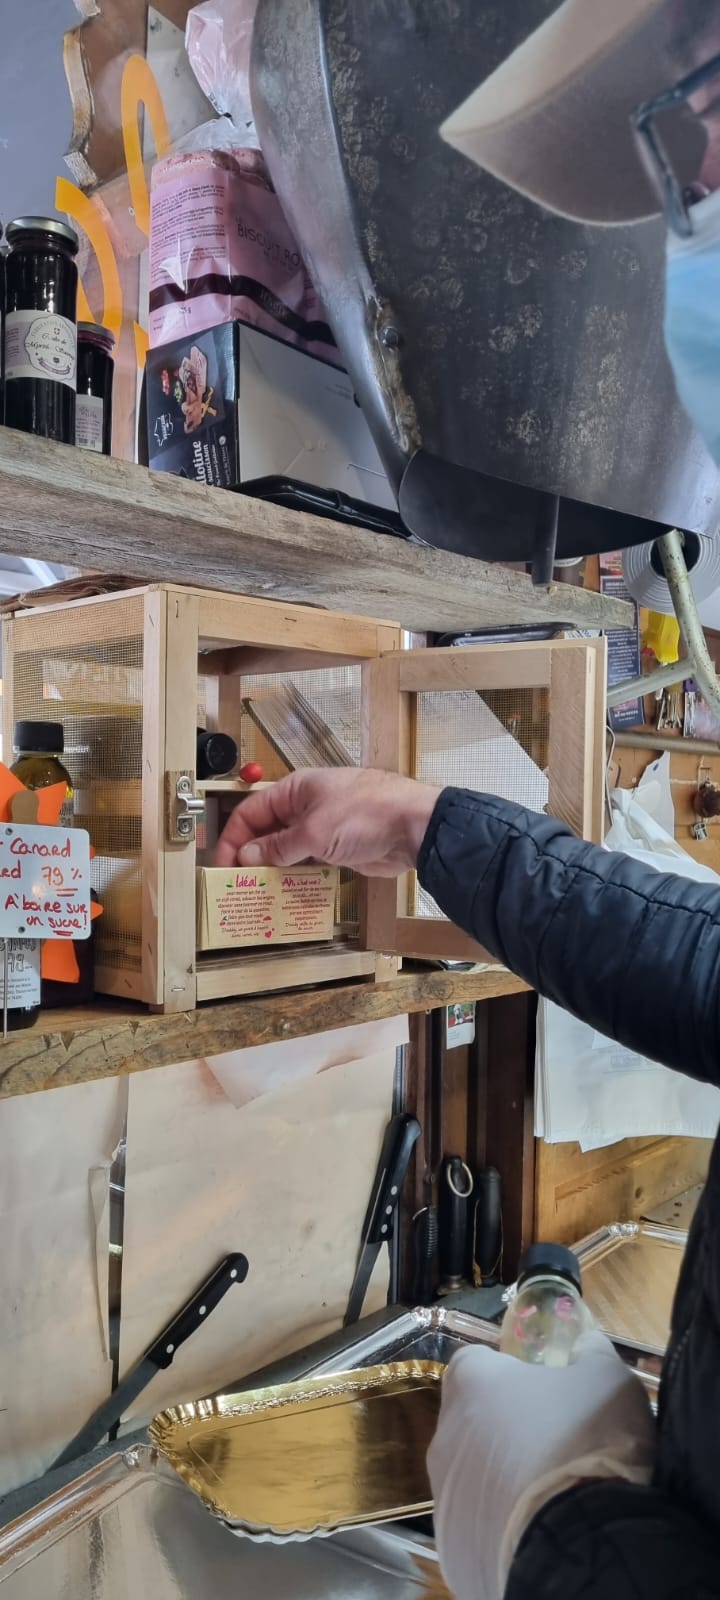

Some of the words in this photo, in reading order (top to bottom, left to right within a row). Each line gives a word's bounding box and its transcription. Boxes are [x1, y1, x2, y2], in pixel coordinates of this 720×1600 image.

[237, 223, 281, 257] BISCUIT
[10, 837, 71, 857] Canard
[41, 865, 64, 886] 79
[236, 873, 257, 888] Idéal
[22, 894, 62, 913] boire
[66, 903, 88, 914] sur
[26, 915, 44, 926] un
